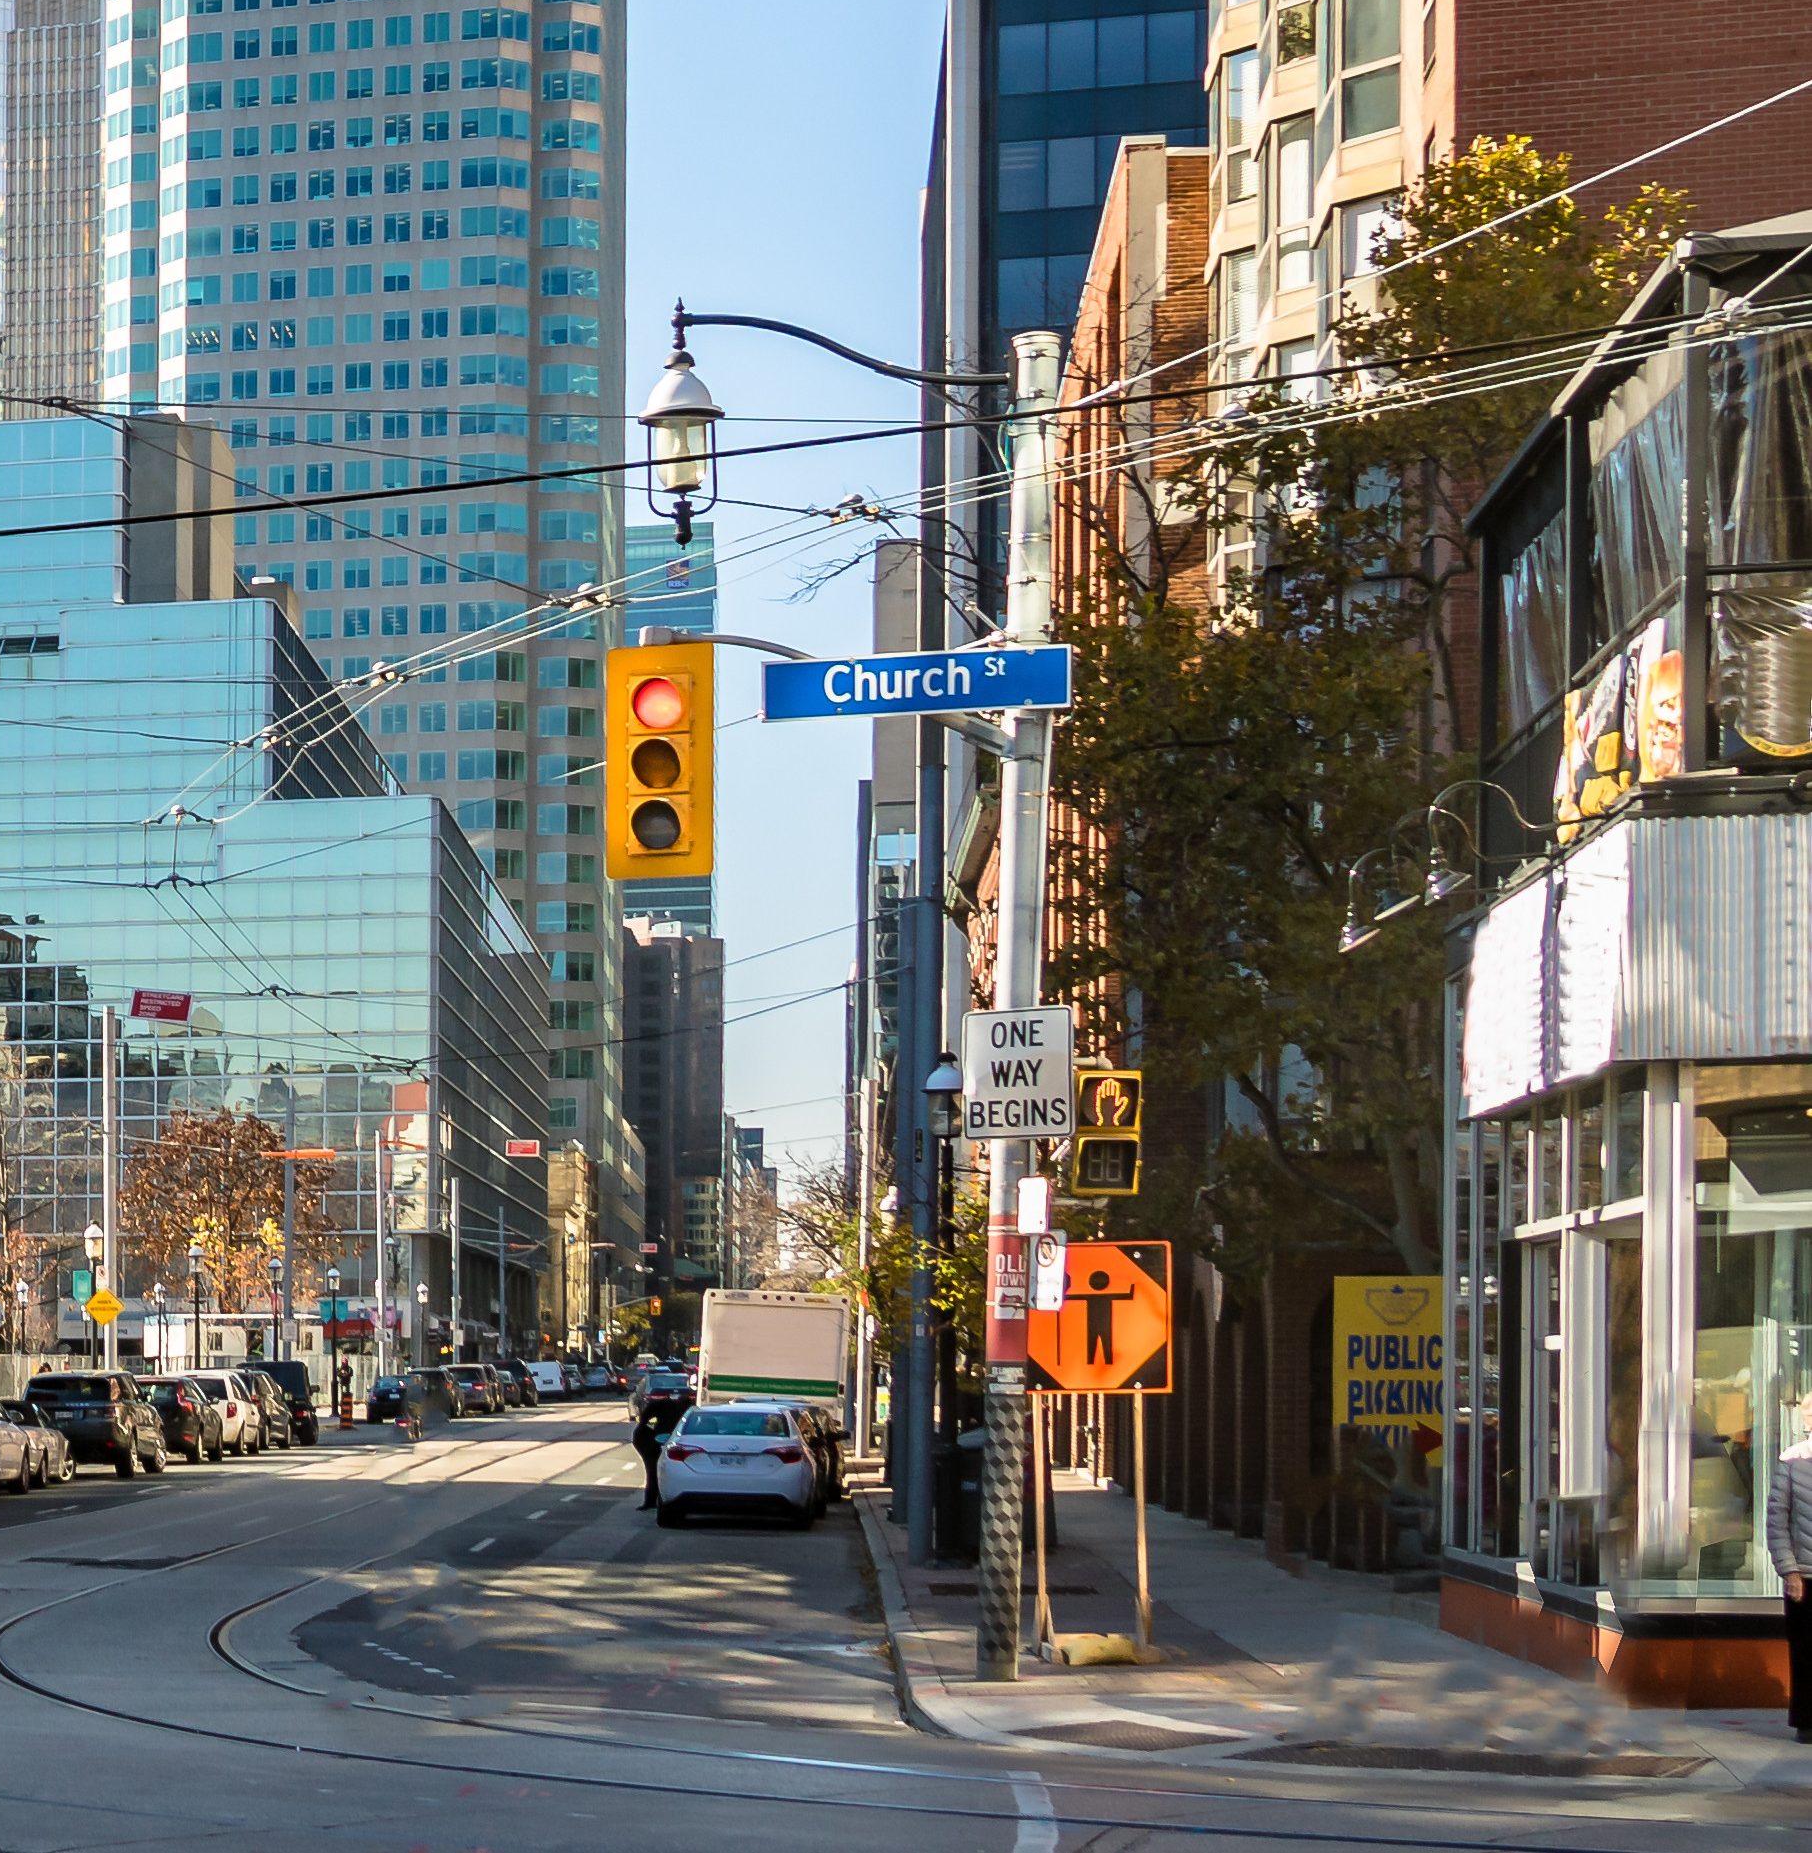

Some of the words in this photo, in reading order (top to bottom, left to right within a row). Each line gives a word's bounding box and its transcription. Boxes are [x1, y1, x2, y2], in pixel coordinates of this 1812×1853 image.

[824, 659, 970, 703] Church
[984, 656, 1007, 676] St
[991, 1020, 1043, 1048] ONE
[991, 1059, 1043, 1087] WAY
[970, 1098, 1066, 1128] BEGINS
[996, 1274, 1025, 1286] TOWN
[1347, 1335, 1443, 1370] PUBLIC
